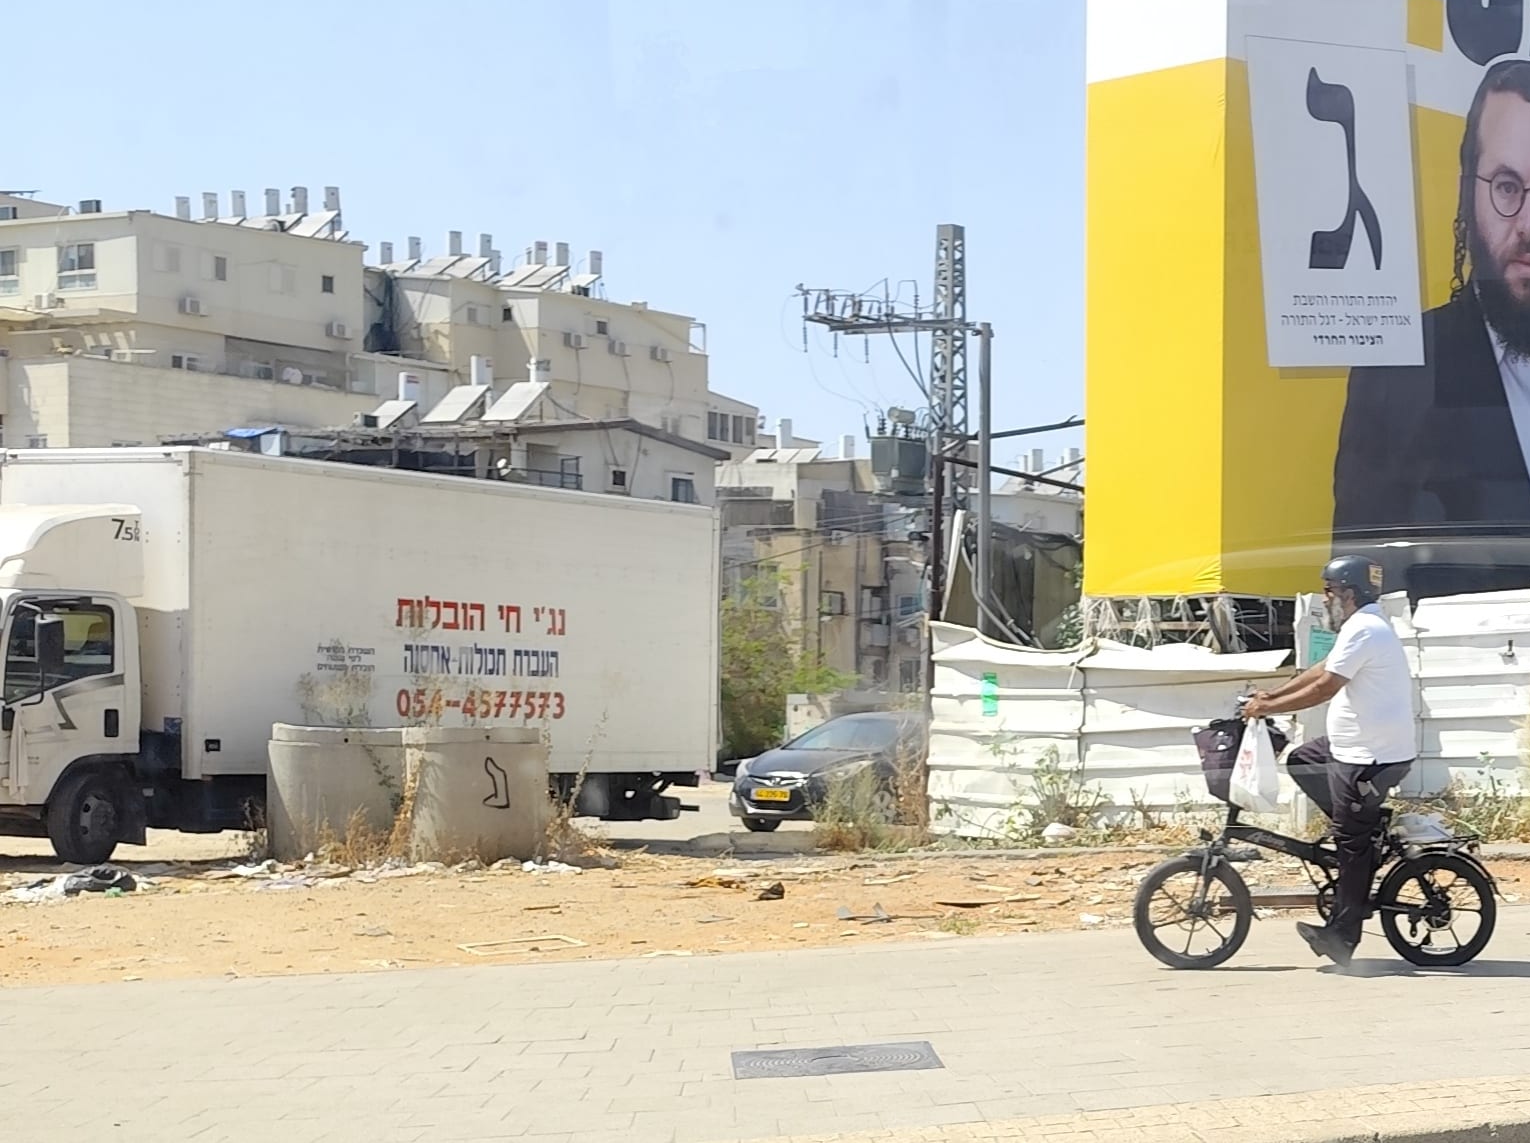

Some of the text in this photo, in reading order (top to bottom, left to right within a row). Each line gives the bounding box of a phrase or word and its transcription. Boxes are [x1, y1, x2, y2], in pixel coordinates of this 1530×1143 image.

[1306, 67, 1382, 270] ג
[1292, 295, 1397, 306] יהדות התורה והשבת
[1281, 315, 1317, 326] התורה
[1318, 312, 1336, 326] דגל
[1344, 312, 1378, 326] ישראל
[1380, 315, 1411, 326] אגודת
[1313, 335, 1384, 346] הציבור החרדי
[112, 518, 133, 541] 7.5
[395, 595, 485, 632] הובלות
[498, 604, 521, 633] חי
[512, 649, 559, 678] העברת
[397, 688, 566, 720] 054-4577573
